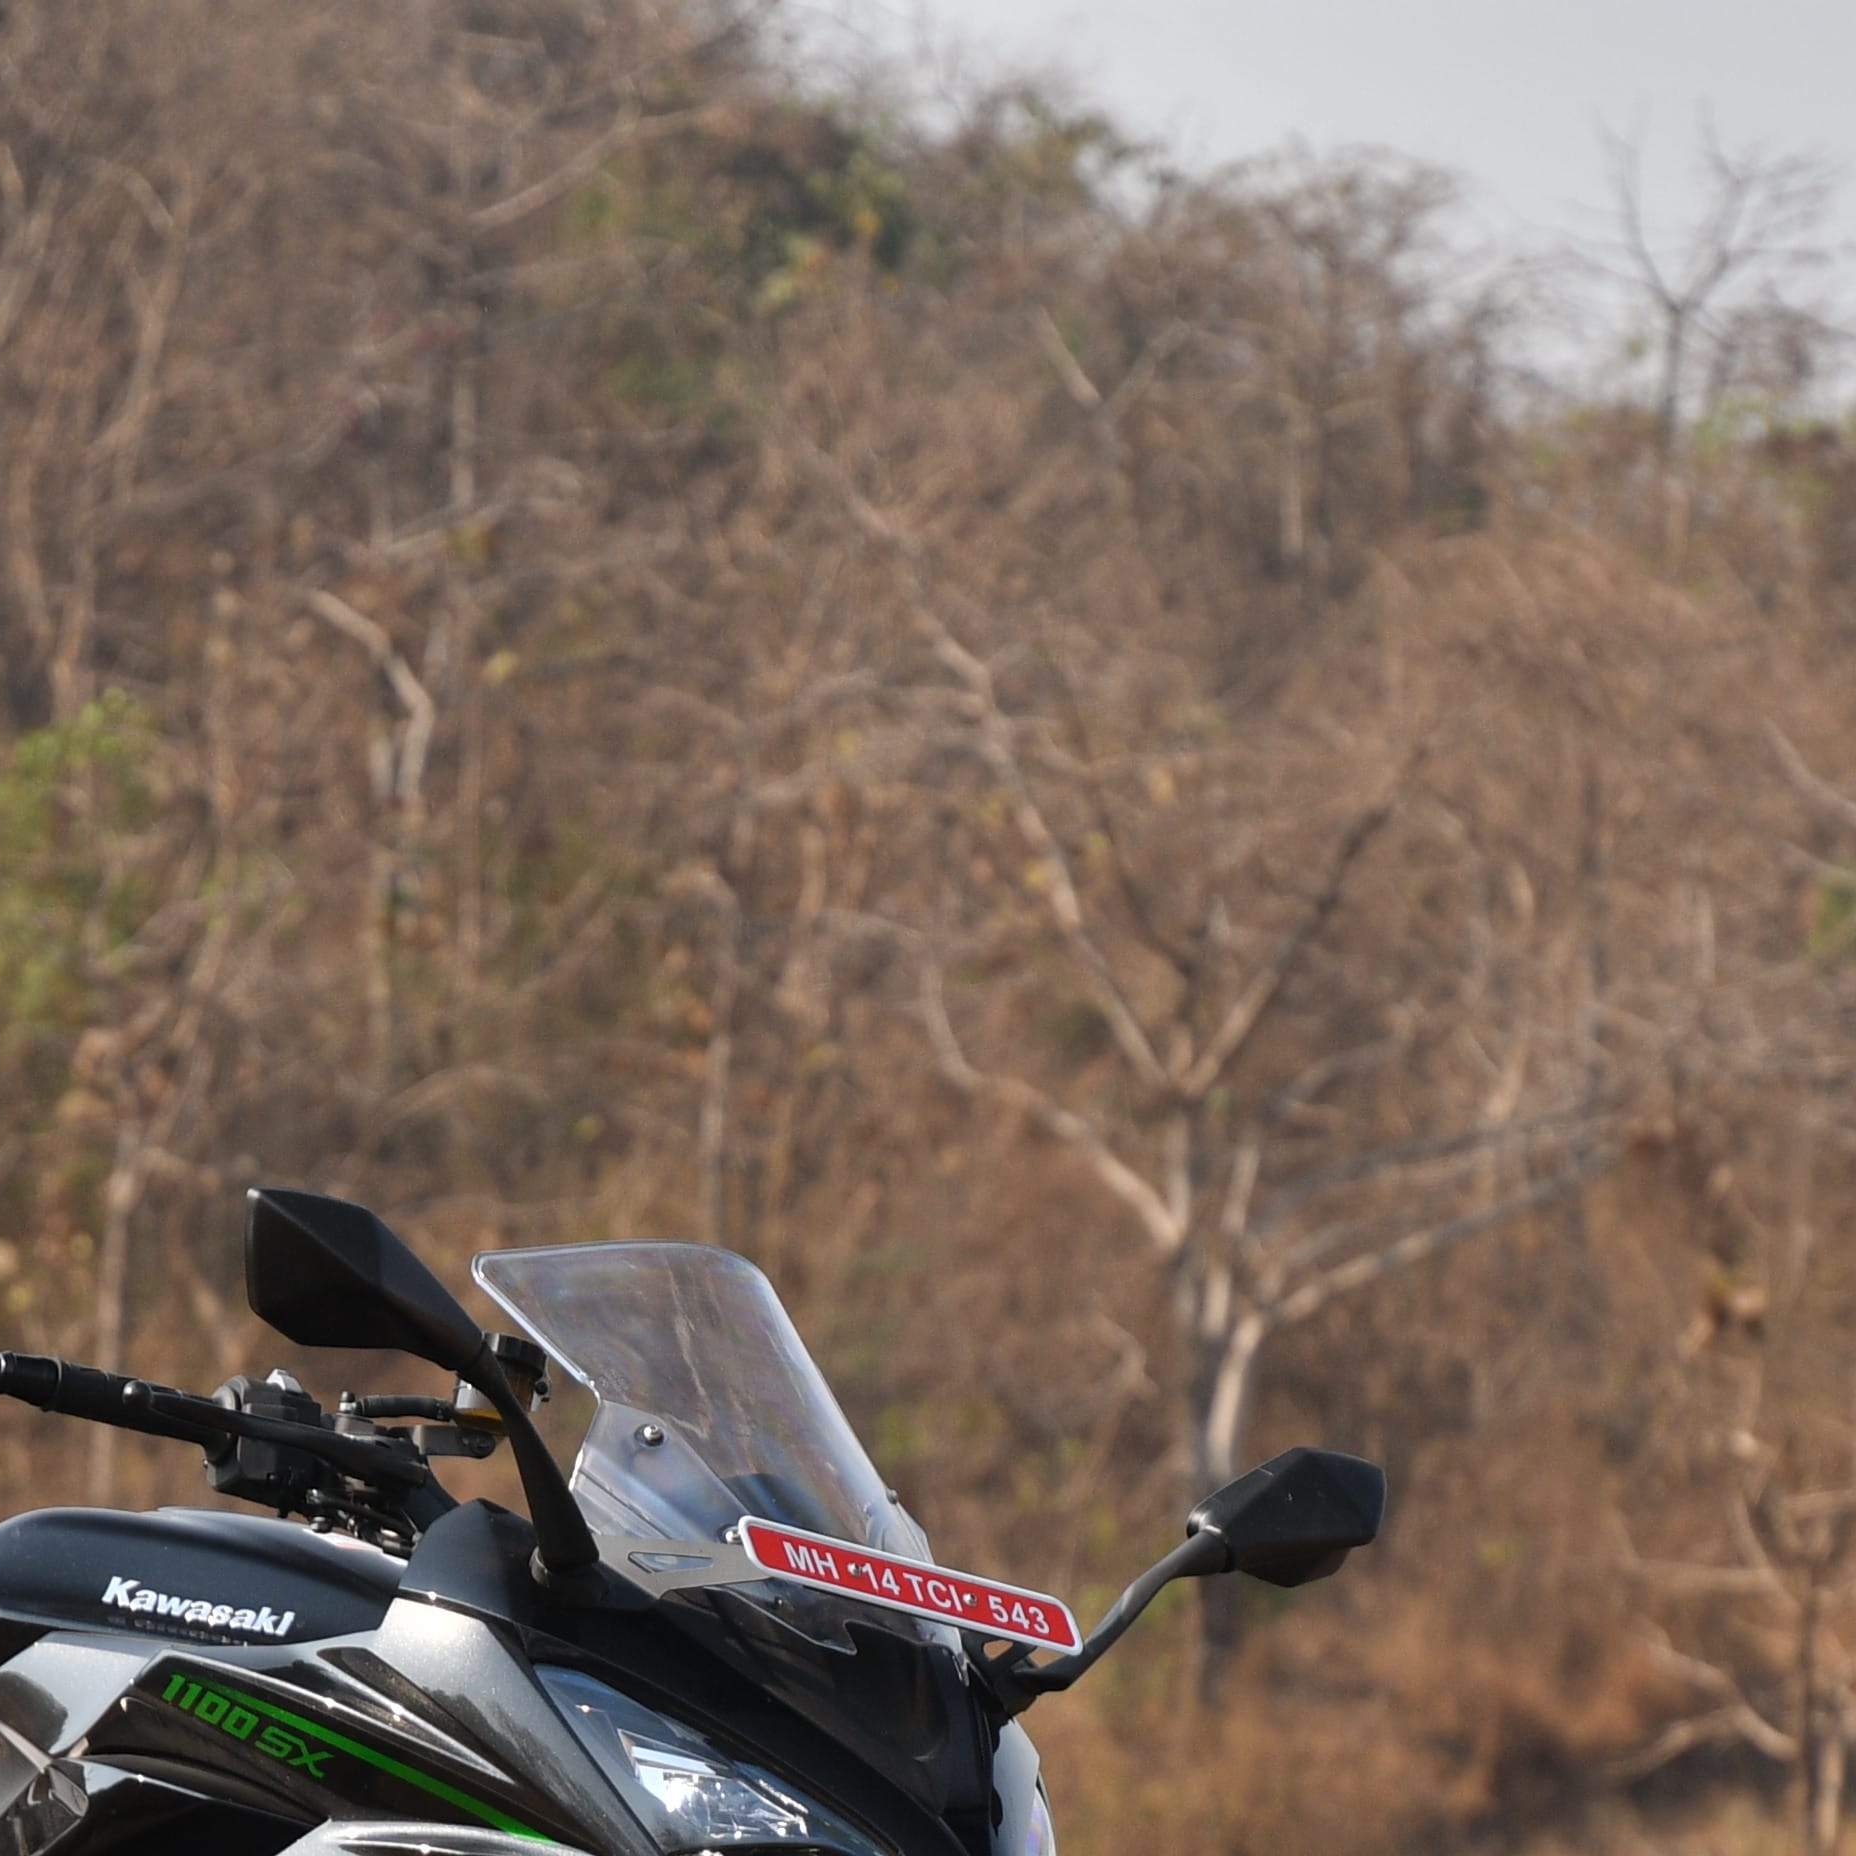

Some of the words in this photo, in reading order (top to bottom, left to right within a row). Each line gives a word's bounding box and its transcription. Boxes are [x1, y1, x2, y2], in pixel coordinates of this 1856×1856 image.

[102, 1576, 296, 1637] Kawasaki
[782, 1541, 840, 1580] MH
[988, 1594, 1050, 1634] 543
[161, 1674, 259, 1740] 1100
[257, 1725, 335, 1778] SX
